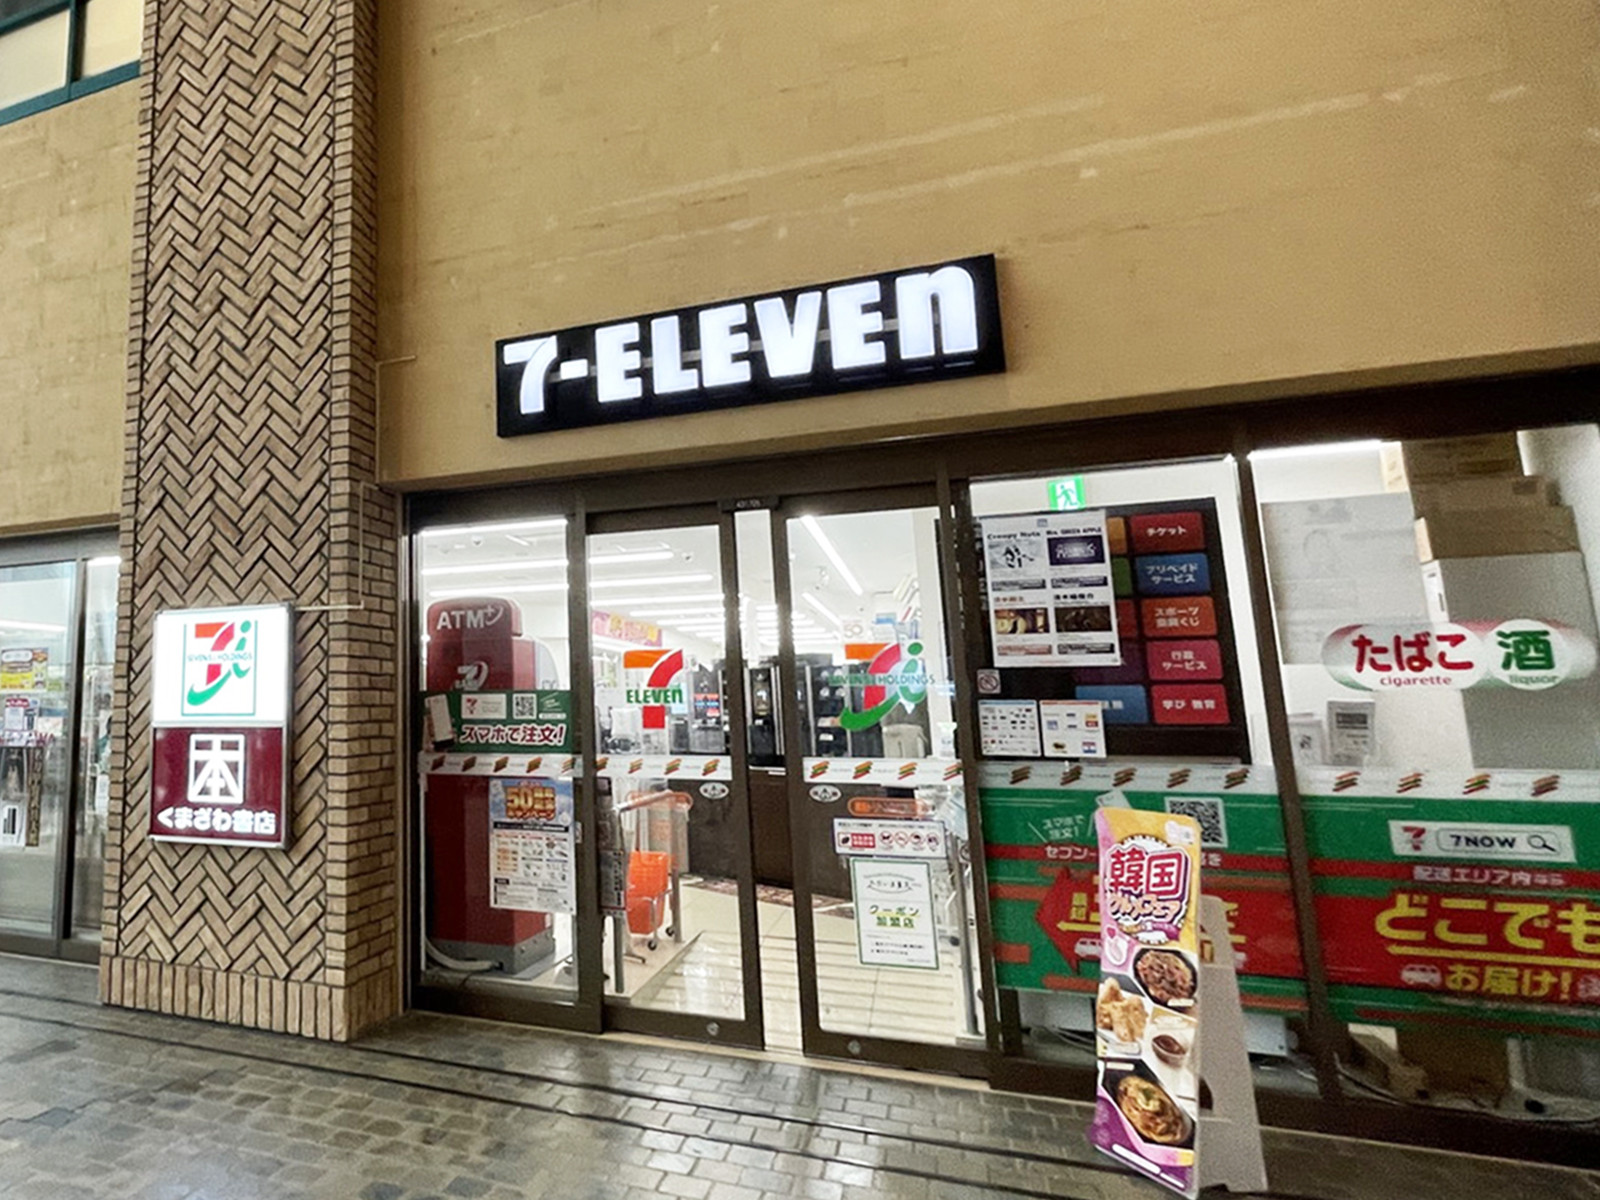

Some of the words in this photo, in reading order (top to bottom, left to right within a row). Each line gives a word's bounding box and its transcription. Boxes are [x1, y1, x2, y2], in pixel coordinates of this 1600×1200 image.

[1146, 525, 1187, 537] チケット
[1145, 563, 1198, 575] プリペイド
[1151, 574, 1196, 584] サービス
[1155, 606, 1199, 617] スポーツ
[1352, 632, 1474, 673] たばこ
[1497, 630, 1555, 670] 酒
[1162, 660, 1207, 671] サービス
[878, 674, 935, 685] HOLDINGS
[1380, 677, 1452, 686] cigarette
[1509, 673, 1559, 684] liquor
[460, 724, 566, 746] スマホで注文!
[157, 806, 276, 835] くまざわ書店
[1449, 834, 1516, 848] 7NOW
[1109, 847, 1182, 897] 韓国
[870, 904, 919, 916] クーポン
[1375, 894, 1600, 955] どこでも
[1445, 964, 1572, 999] お届け!
